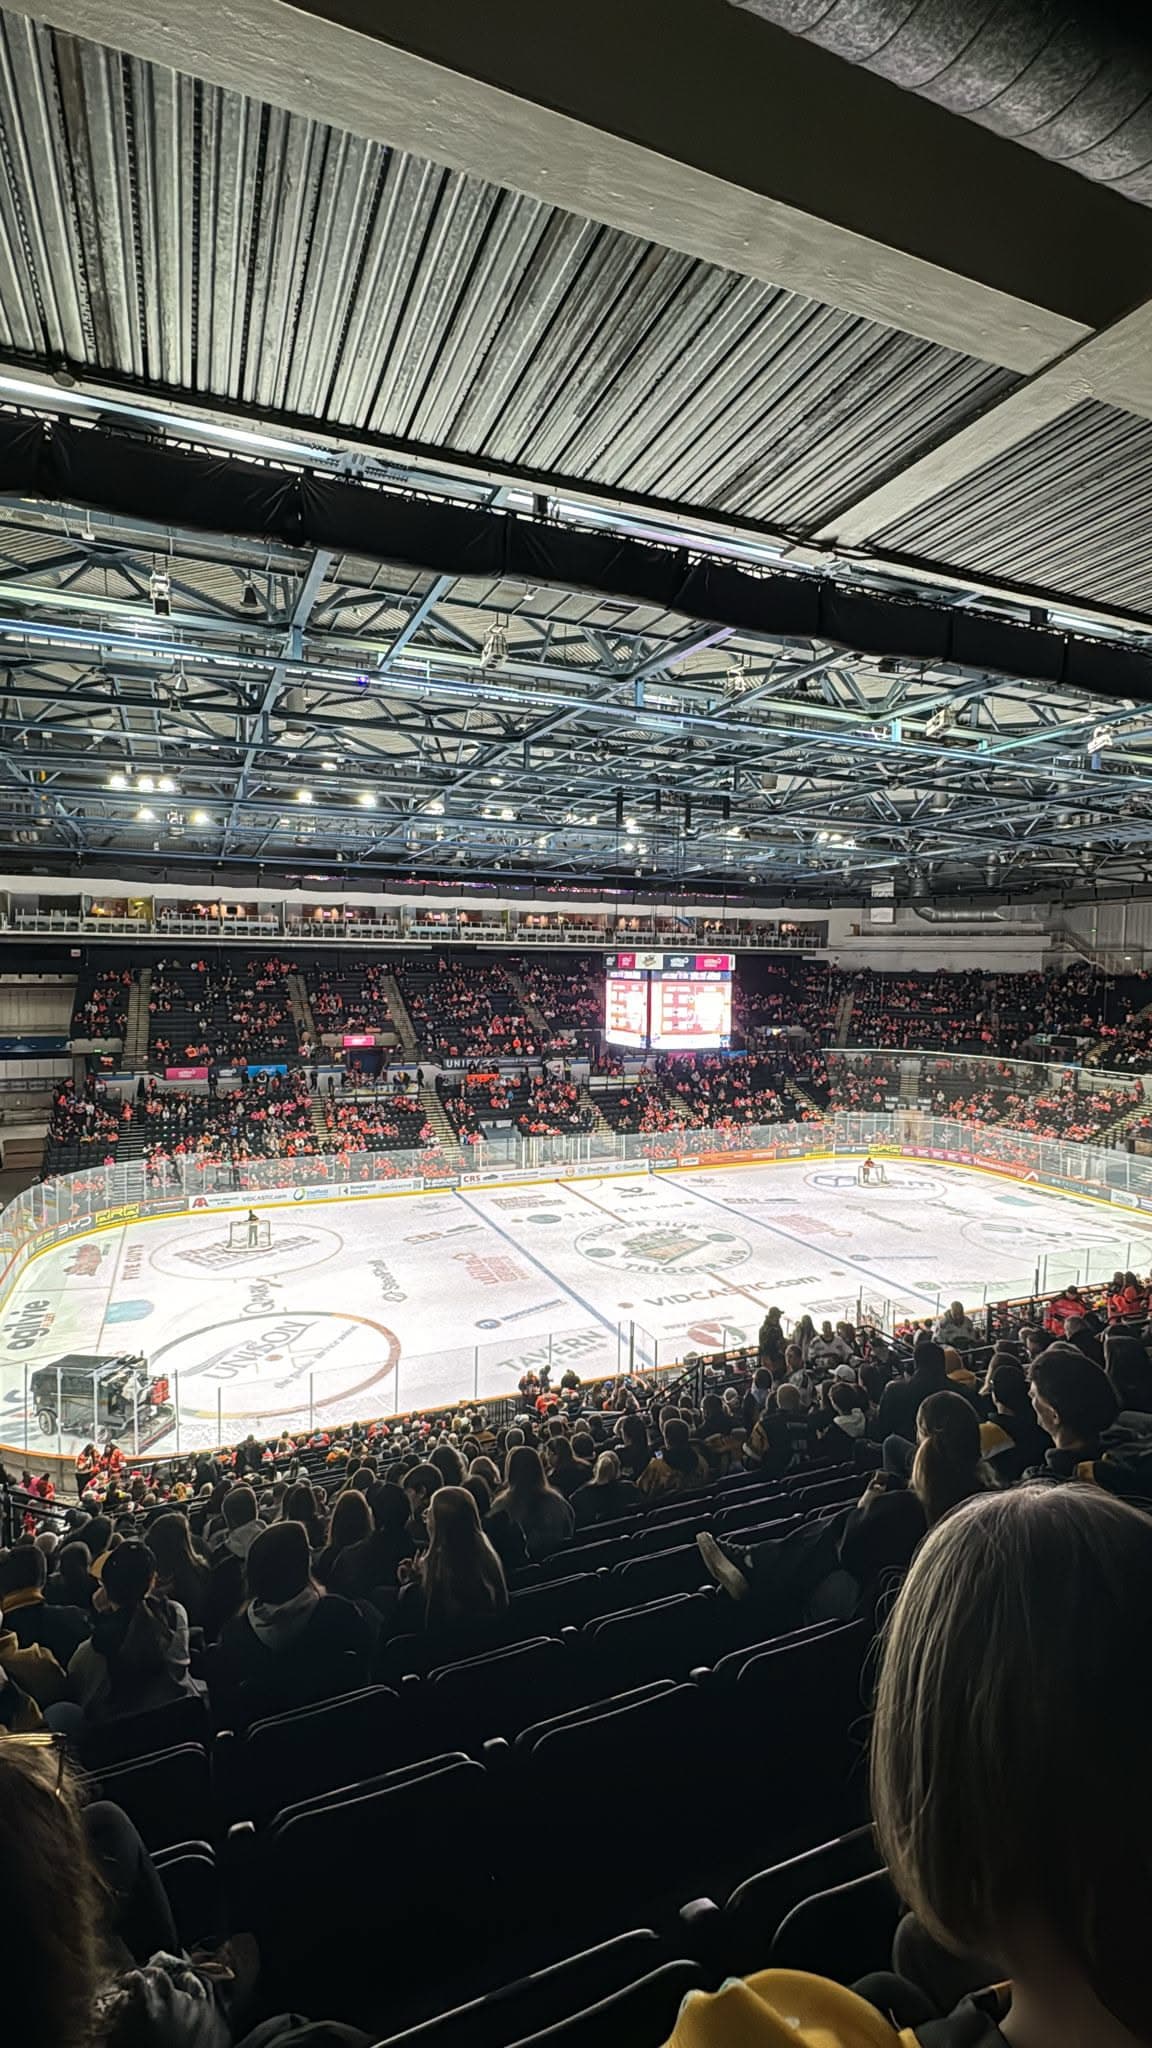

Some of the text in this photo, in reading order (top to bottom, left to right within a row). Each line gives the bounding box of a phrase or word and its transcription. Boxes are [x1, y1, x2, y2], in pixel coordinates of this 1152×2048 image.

[446, 1059, 479, 1067] UNIFY
[463, 1175, 481, 1183] CRS
[58, 1216, 92, 1234] BYD
[644, 1275, 822, 1307] VIDCASTIC.com
[2, 1300, 50, 1350] ogilvie
[202, 1320, 309, 1379] UNISON
[496, 1330, 607, 1370] TAVERN
